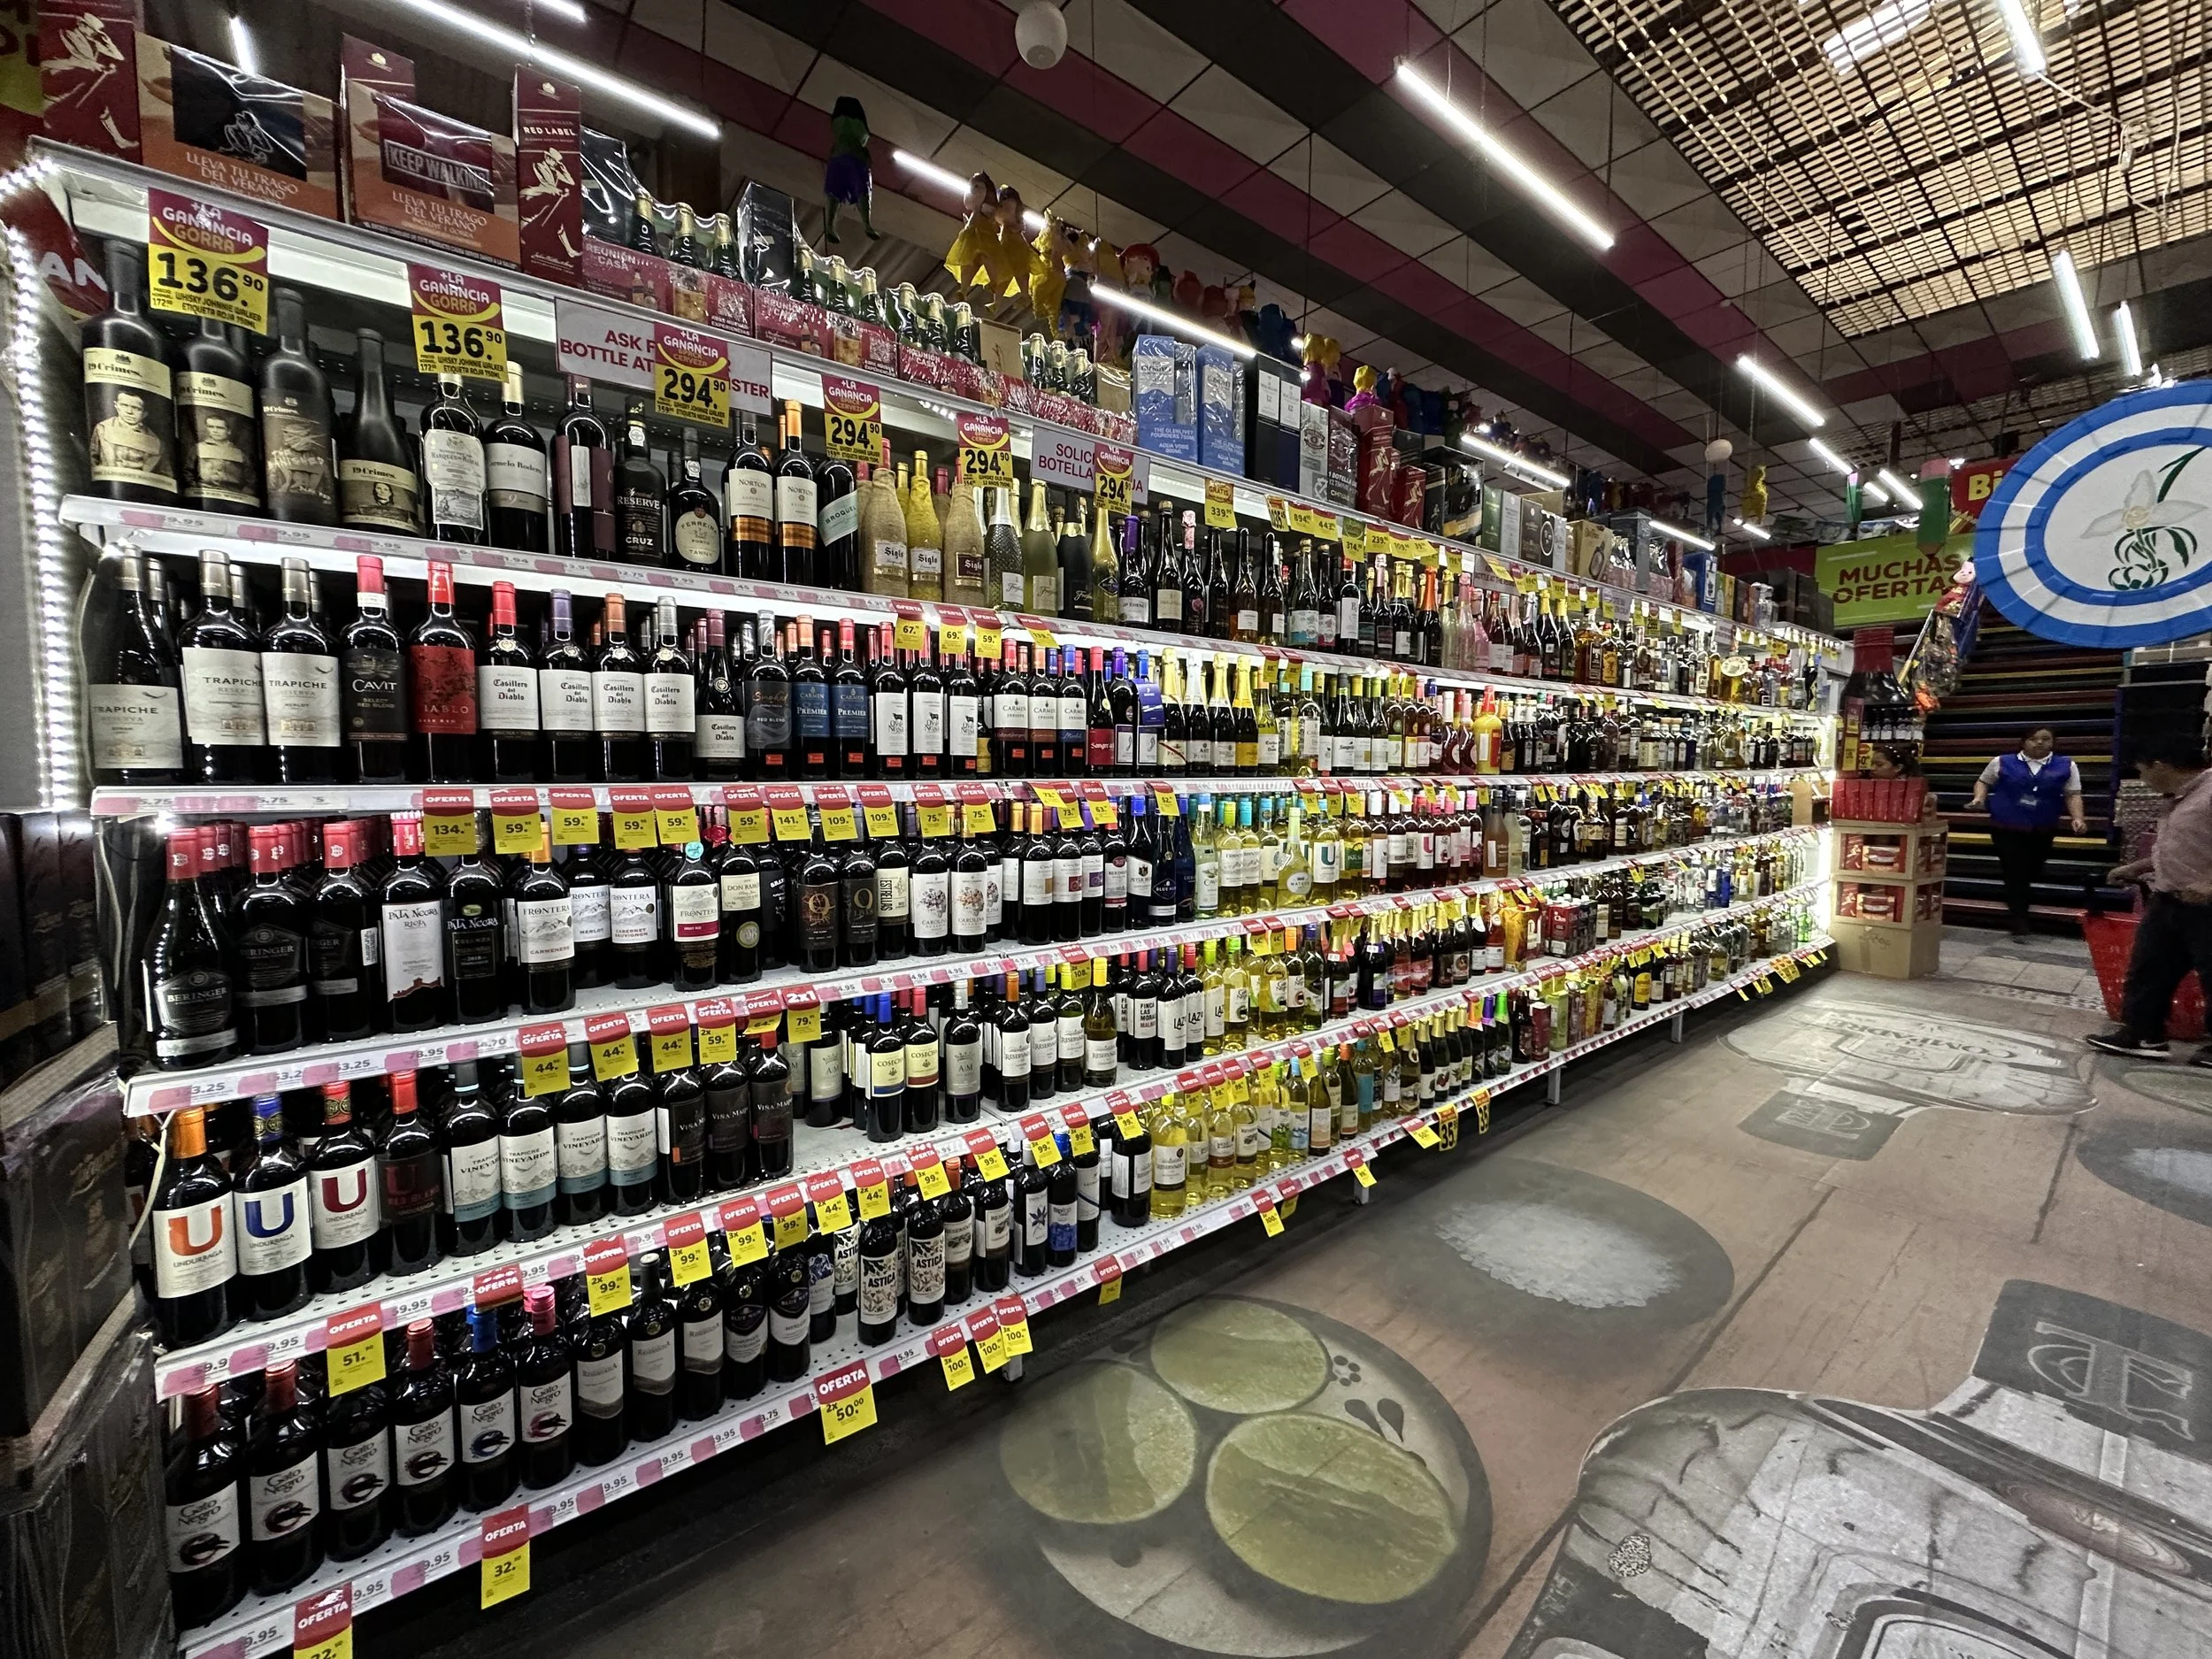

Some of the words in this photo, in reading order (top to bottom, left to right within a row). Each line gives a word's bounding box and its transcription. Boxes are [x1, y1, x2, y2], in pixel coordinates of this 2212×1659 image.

[187, 152, 227, 171] LLEVA
[231, 165, 250, 178] TU
[253, 171, 299, 195] TRAGO
[389, 146, 424, 173] KEEP
[427, 157, 490, 189] WALKING
[201, 166, 227, 182] DEL
[232, 175, 285, 200] VERANO
[392, 192, 426, 211] LLEVA
[431, 203, 446, 215] TU
[449, 206, 487, 226] TRAGO
[162, 207, 253, 246] GANNCIA
[404, 204, 428, 219] DEL
[431, 212, 476, 233] VERANO
[174, 224, 234, 253] GORRA
[597, 255, 629, 272] CASA
[440, 272, 465, 285] +LA
[419, 280, 489, 303] GANANCIA
[430, 293, 476, 313] GORRA
[605, 329, 639, 351] ASK
[680, 330, 699, 342] +LA
[664, 336, 718, 357] GANANCIA
[561, 340, 626, 365] BOTTLE
[633, 353, 655, 373] AT
[97, 363, 142, 378] Crimes
[187, 386, 227, 398] Crimes
[829, 386, 872, 403] GANANCIA
[964, 423, 1003, 435] GANANCIA
[1101, 451, 1130, 465] GANANCIA
[518, 461, 542, 473] Rodero
[1039, 456, 1093, 480] BOTELLA
[617, 495, 660, 510] RESERVE
[826, 503, 857, 524] BROQUEL
[918, 553, 937, 565] Siglo
[1839, 555, 1961, 585] MUCHAS
[896, 603, 922, 613] OFERTA
[352, 679, 397, 694] CAVIT
[880, 879, 892, 911] ESTRELLAS
[167, 987, 227, 1002] BERINGER
[589, 1018, 626, 1032] OFERTA
[651, 1013, 685, 1024] OFERTA
[523, 1033, 562, 1044] OFERTA
[854, 1166, 881, 1179] OFERTA
[322, 1169, 366, 1212] U
[245, 1193, 294, 1238] U
[326, 1208, 367, 1222] UNDURRAGA
[725, 1206, 756, 1219] OFERTA
[168, 1206, 222, 1256] U
[669, 1223, 702, 1236] OFERTA
[249, 1233, 295, 1248] UNDURRAGA
[173, 1249, 222, 1267] UNDURRAGA
[586, 1247, 624, 1263] OFERTA
[917, 1255, 942, 1268] ASTICA
[476, 1278, 518, 1294] OFERTA
[869, 1272, 895, 1287] ASTICA
[999, 1305, 1022, 1315] OFERTA
[329, 1314, 378, 1334] OFERTA
[938, 1333, 961, 1346] OFERTA
[819, 1369, 865, 1394] OFERTA
[531, 1389, 561, 1406] Negro
[533, 1383, 558, 1398] Gato
[471, 1405, 504, 1425] Negro
[474, 1401, 501, 1417] Gato
[264, 1474, 304, 1495] Negro
[267, 1468, 302, 1487] Gato
[179, 1504, 220, 1526] Negro
[180, 1499, 217, 1517] Gato
[485, 1521, 526, 1542] OFERTA
[298, 1602, 348, 1629] OFERTA
